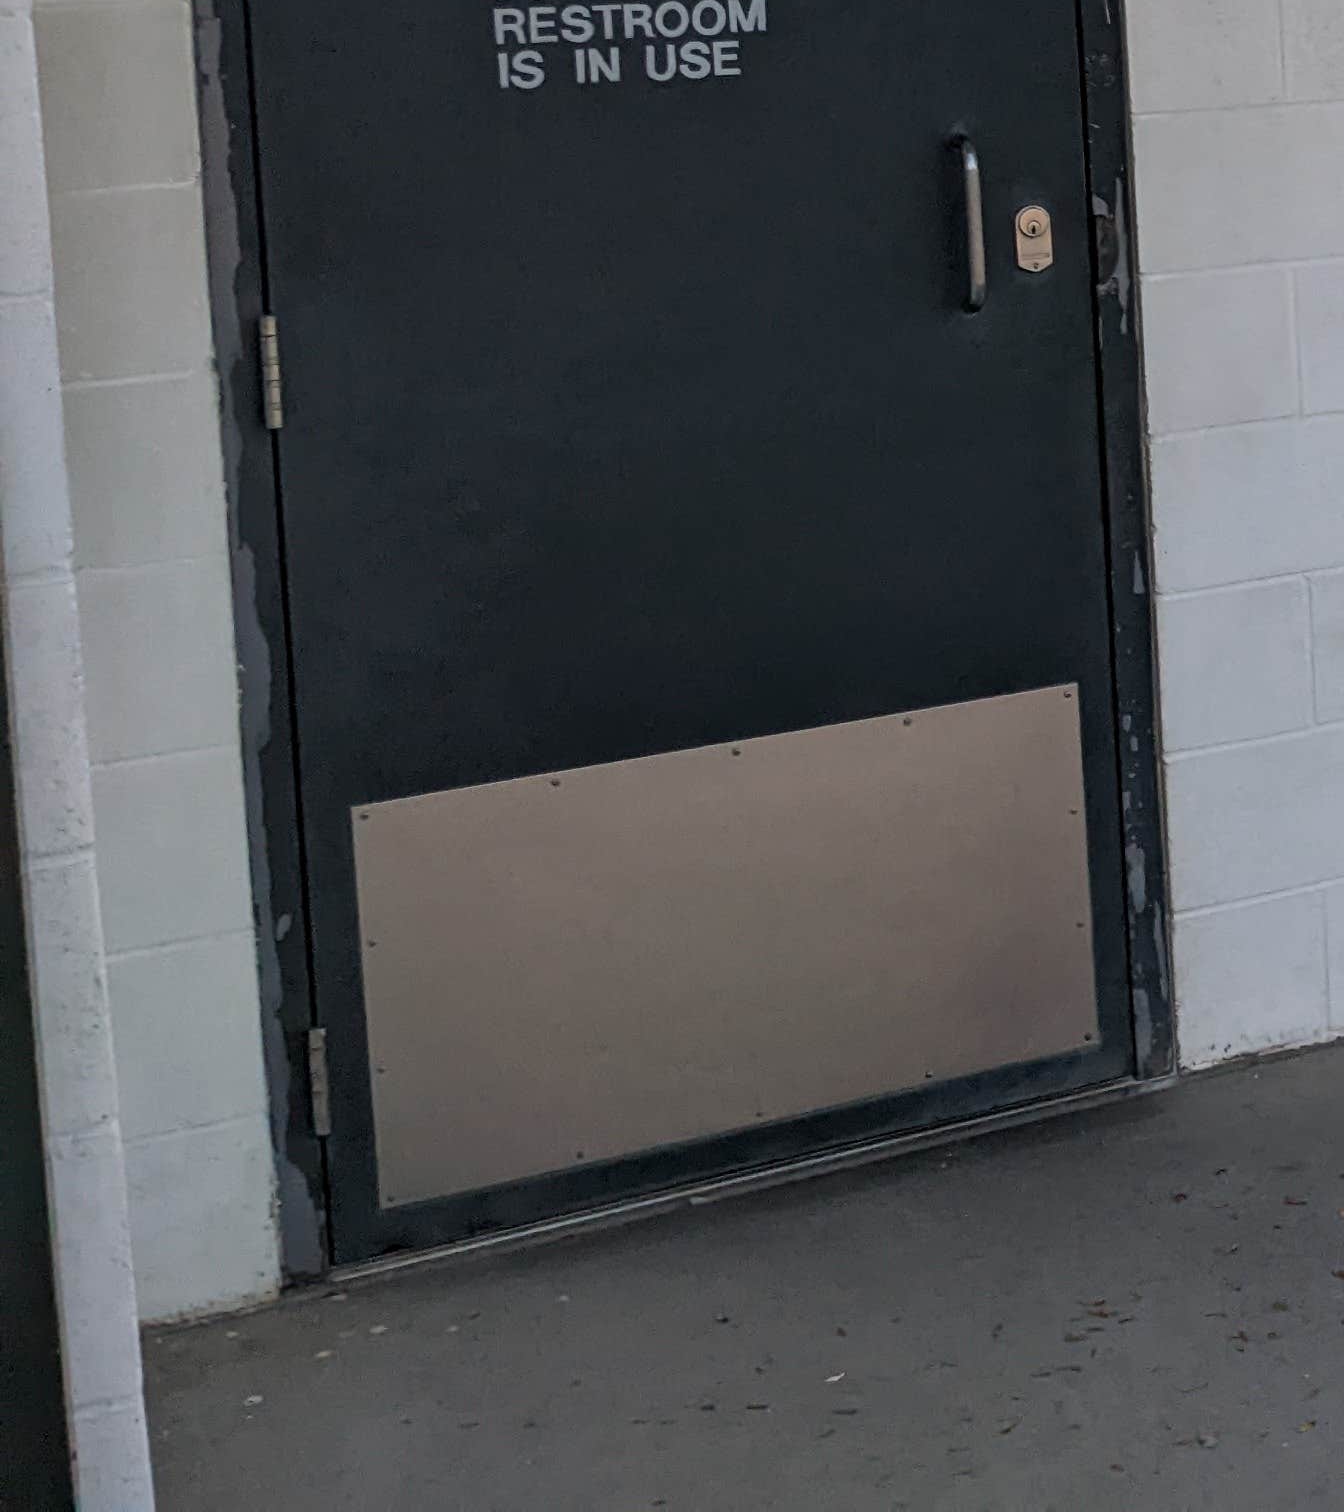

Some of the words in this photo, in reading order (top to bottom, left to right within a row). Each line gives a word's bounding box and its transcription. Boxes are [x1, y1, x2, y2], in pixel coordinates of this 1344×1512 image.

[498, 50, 546, 89] IS
[574, 47, 621, 85] IN
[646, 40, 742, 82] USE
